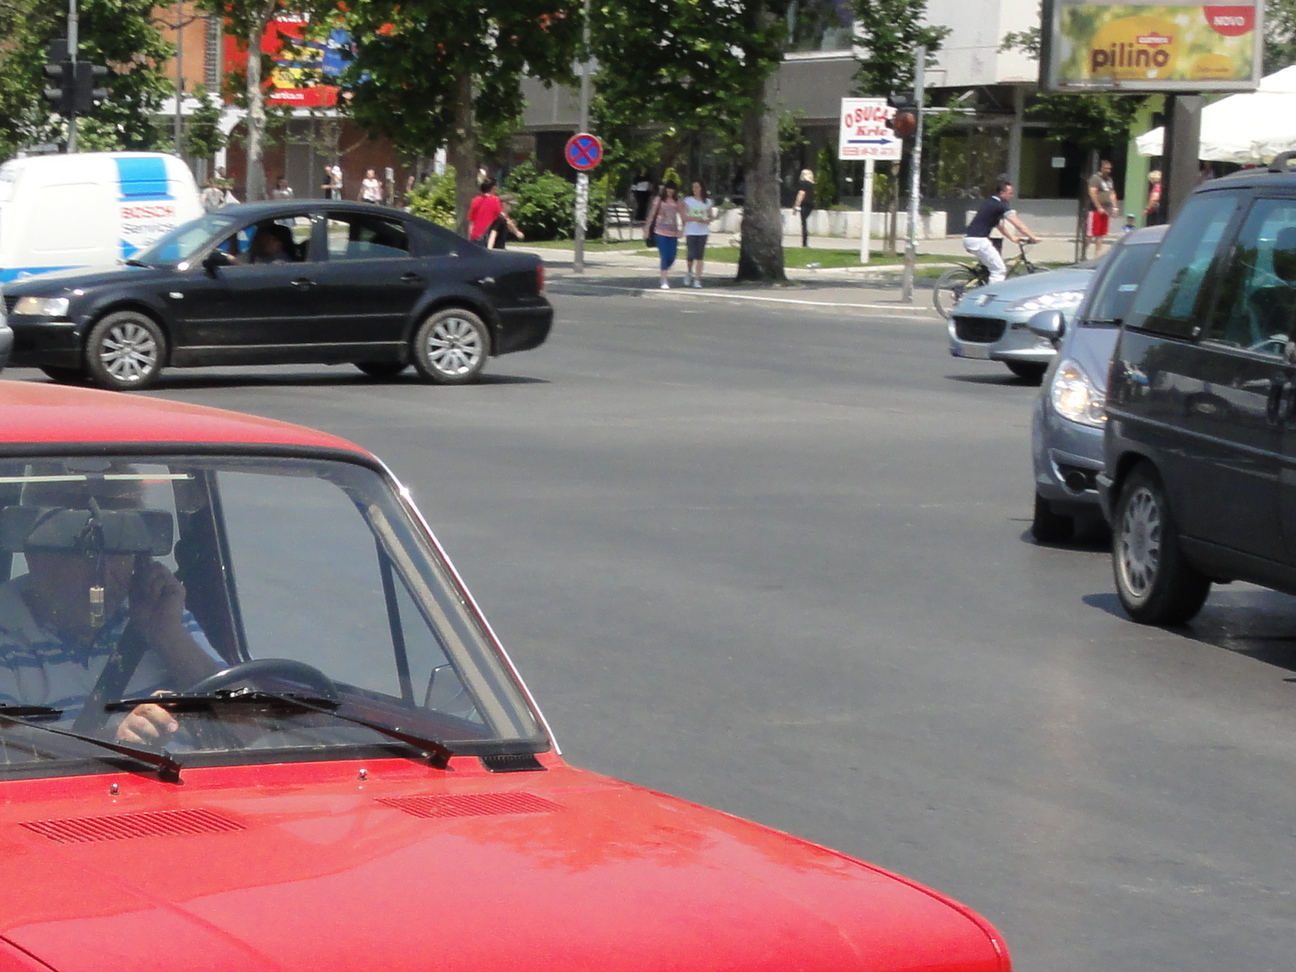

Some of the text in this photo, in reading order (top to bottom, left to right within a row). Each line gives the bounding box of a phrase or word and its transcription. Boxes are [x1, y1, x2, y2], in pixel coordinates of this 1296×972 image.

[1214, 16, 1245, 26] NOVO
[1092, 43, 1169, 73] pilino
[121, 206, 176, 218] BOSCH
